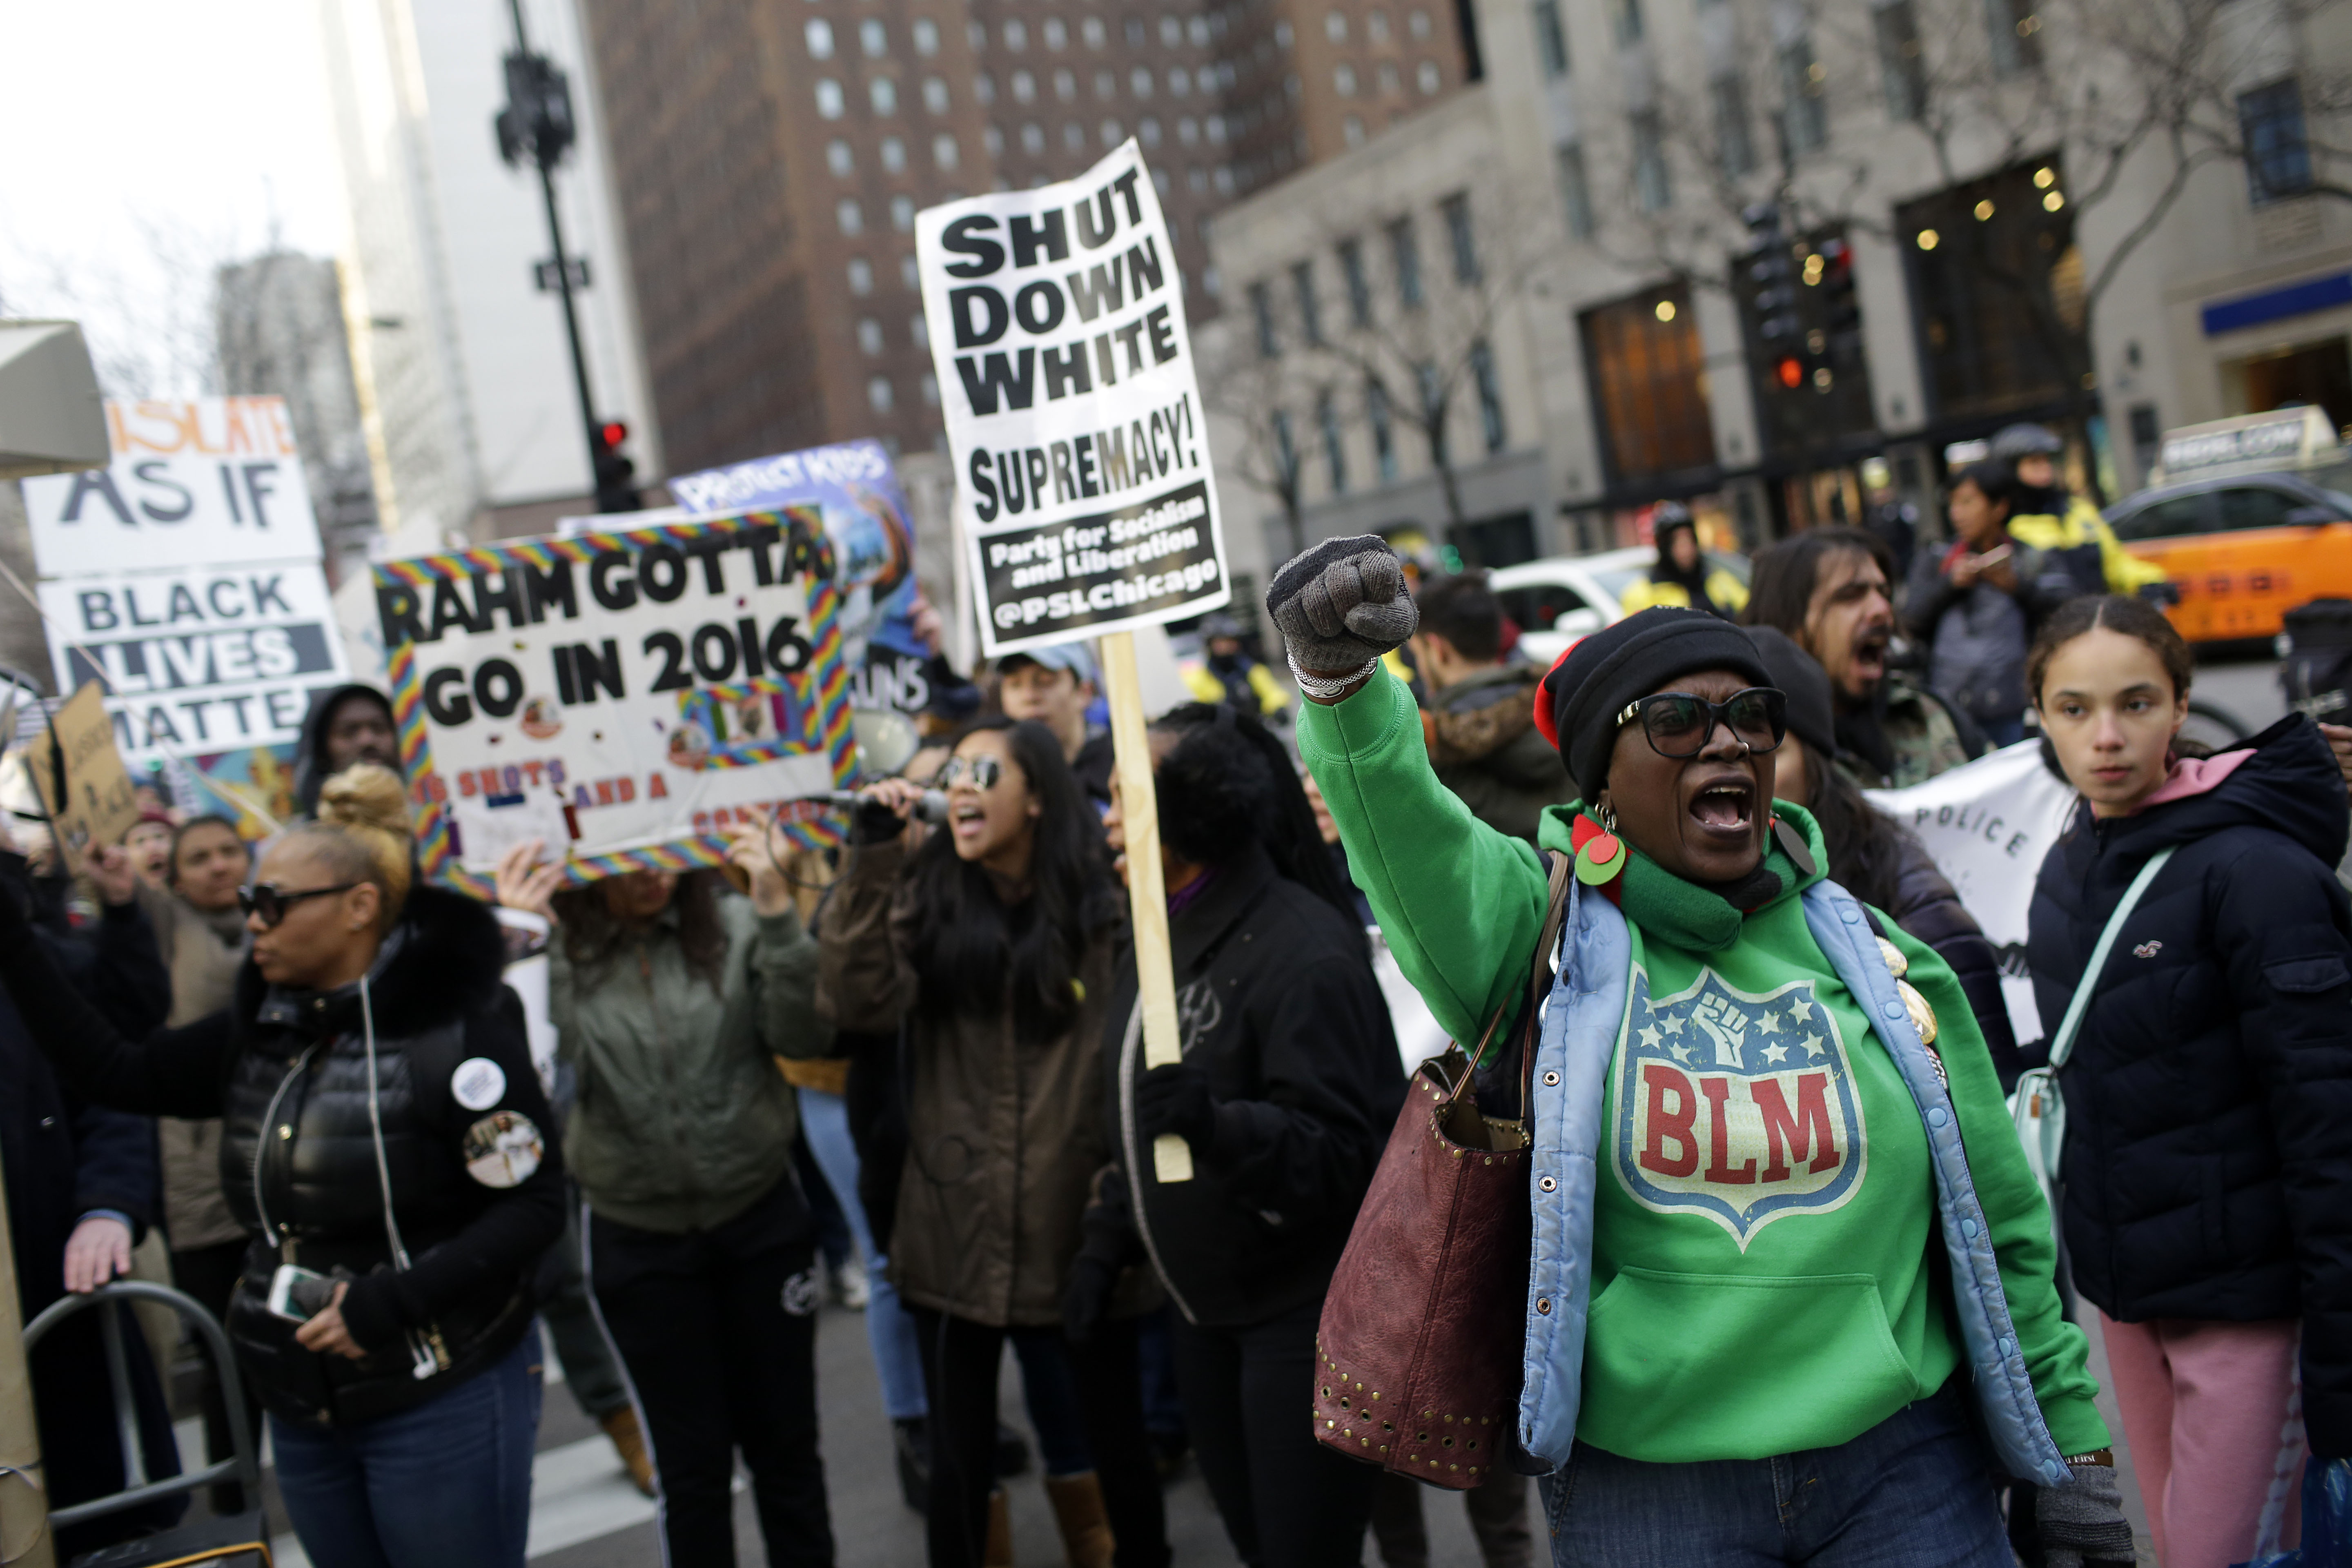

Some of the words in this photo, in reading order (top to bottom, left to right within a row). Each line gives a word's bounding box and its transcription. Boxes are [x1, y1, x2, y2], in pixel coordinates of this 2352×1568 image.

[942, 165, 1142, 279] SHUT
[949, 235, 1164, 349] DOWN
[955, 303, 1178, 416] WHITE
[970, 394, 1199, 522] SUPREMACY!
[59, 461, 194, 525] AS
[220, 462, 278, 528] IF
[989, 534, 1062, 568] Party
[1062, 524, 1106, 551] for
[1108, 495, 1206, 543] Socialism
[1011, 557, 1064, 589] and
[1065, 527, 1199, 578] Liberation
[77, 577, 292, 632] BLACK
[377, 555, 579, 646] RAHM
[590, 519, 835, 610] GOTTA
[993, 559, 1218, 629] @PSLChicago
[100, 628, 301, 692] LIVES
[423, 658, 523, 727] GO
[552, 639, 625, 706] IN
[642, 616, 813, 693] 2016
[458, 759, 566, 797] SHOTS
[575, 777, 635, 808] AND
[650, 773, 667, 798] A
[1915, 804, 2029, 859] POLICE
[1640, 1065, 1840, 1185] BLM
